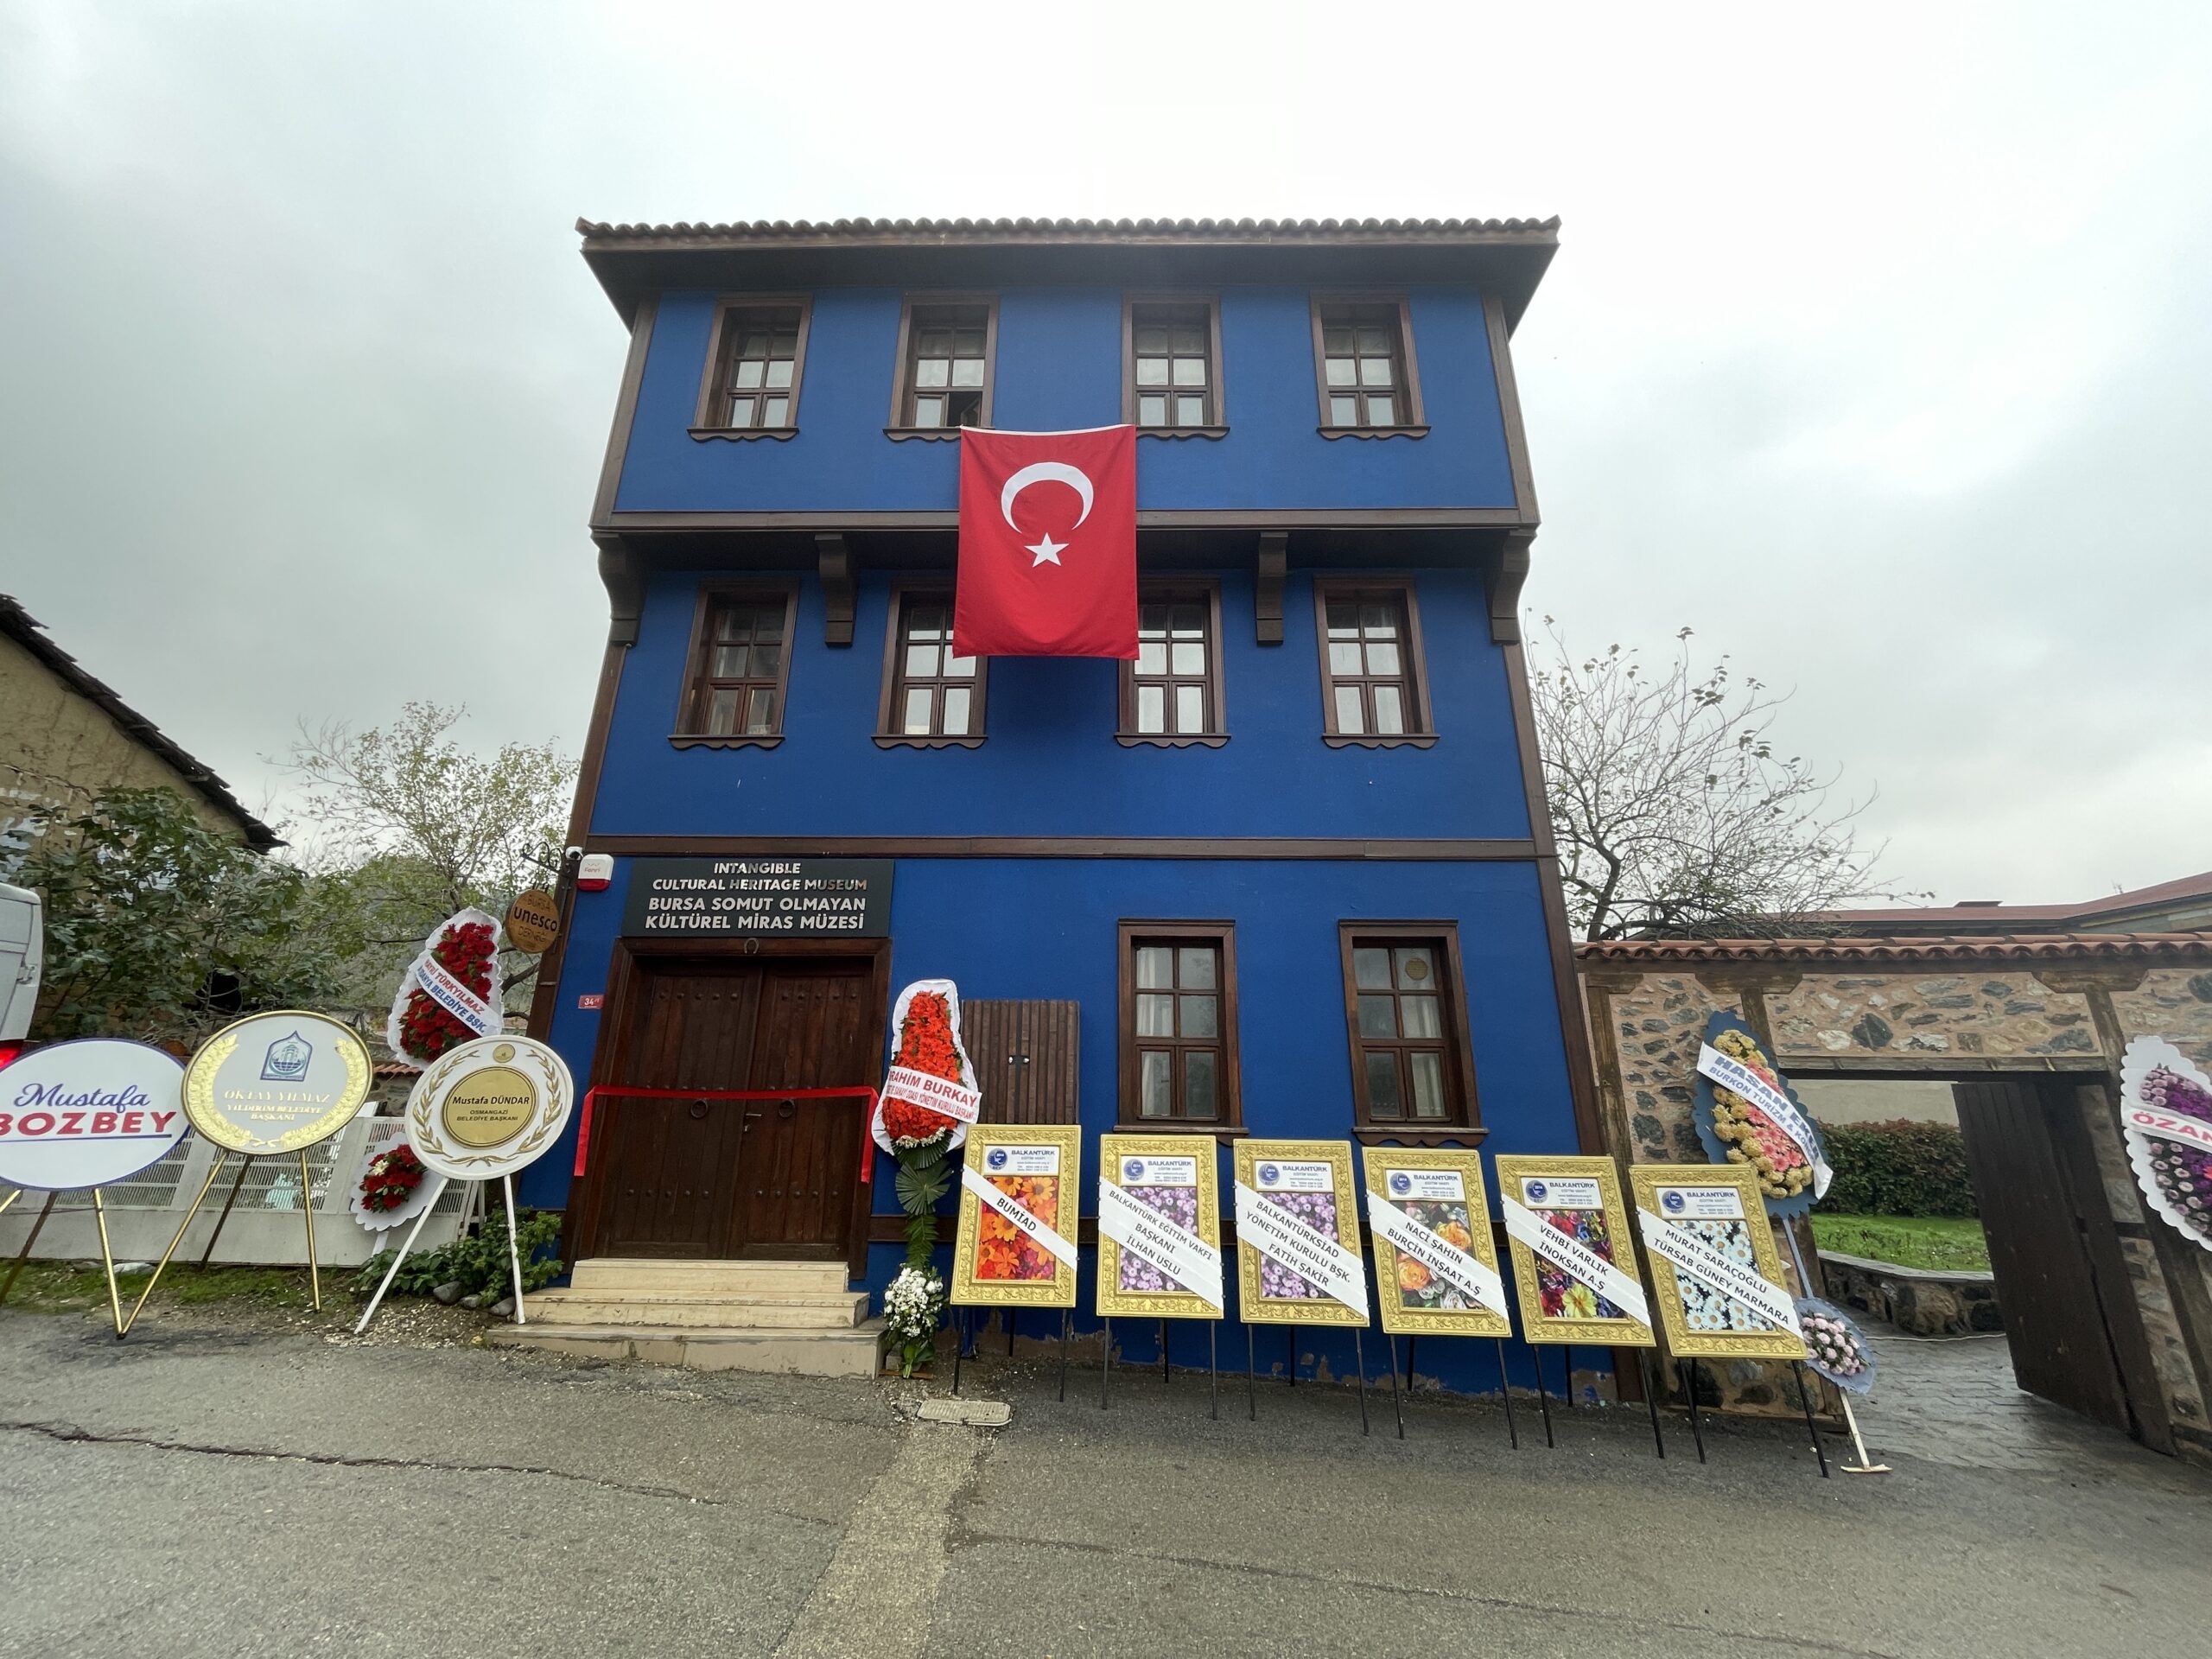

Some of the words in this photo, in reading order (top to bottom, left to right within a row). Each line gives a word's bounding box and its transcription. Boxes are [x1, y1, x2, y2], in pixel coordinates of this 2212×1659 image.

[652, 879, 726, 891] CULTURAL
[729, 879, 801, 891] HERITAGE
[804, 879, 868, 891] MUSEUM
[714, 862, 801, 874] INTANGIBLE
[513, 906, 557, 932] unesco
[645, 913, 731, 929] KÜLTÜREL
[737, 913, 793, 929] MİRAS
[800, 913, 864, 929] MÜZESİ
[648, 897, 706, 911] BURSA
[711, 897, 773, 911] SOMUT
[779, 897, 866, 911] OLMAYAN
[430, 984, 469, 1018] BELEDİYE
[435, 972, 486, 1015] TÜRKYILMAZ
[14, 1083, 151, 1114] Mustafa
[452, 1096, 488, 1105] Mustafa
[491, 1096, 530, 1104] DÜNDAR
[923, 1079, 977, 1108] BURKAY
[1708, 1066, 1752, 1095] BURKON
[1753, 1093, 1787, 1124] TURİZM
[1786, 1123, 1794, 1132] &
[1714, 1055, 1789, 1112] HASAN
[996, 1198, 1037, 1232] BUMİAD
[1109, 1189, 1158, 1226] BALKANTÜRK
[1158, 1220, 1187, 1246] EĞİTİM
[1186, 1240, 1213, 1261] VAKFI
[1255, 1200, 1340, 1259] BALKANTÜRKSİAD
[1126, 1235, 1155, 1261] İLHAN
[1155, 1254, 1181, 1277] USLU
[1135, 1223, 1177, 1255] BAŞKANI
[1245, 1211, 1288, 1244] YÖNETİM
[1289, 1238, 1329, 1268] KURULU
[1329, 1263, 1351, 1283] BŞK.
[1405, 1222, 1430, 1243] NACİ
[1430, 1236, 1464, 1264] ŞAHİN
[1539, 1224, 1571, 1251] VEHBİ
[1571, 1246, 1610, 1276] VARLIK
[1268, 1243, 1297, 1267] FATİH
[1297, 1261, 1330, 1287] ŞAKİR
[1387, 1227, 1427, 1258] BURÇİN
[1427, 1249, 1464, 1282] İNŞAAT
[1464, 1279, 1482, 1295] A.Ş
[1539, 1242, 1587, 1281] İNOKSAN
[1586, 1274, 1605, 1290] A.Ş
[1654, 1236, 1694, 1267] TÜRSAB
[1695, 1259, 1732, 1291] GÜNEY
[1733, 1287, 1789, 1325] MARMARA
[1665, 1229, 1702, 1255] MURAT
[1703, 1249, 1768, 1294] SARAÇOĞLU
